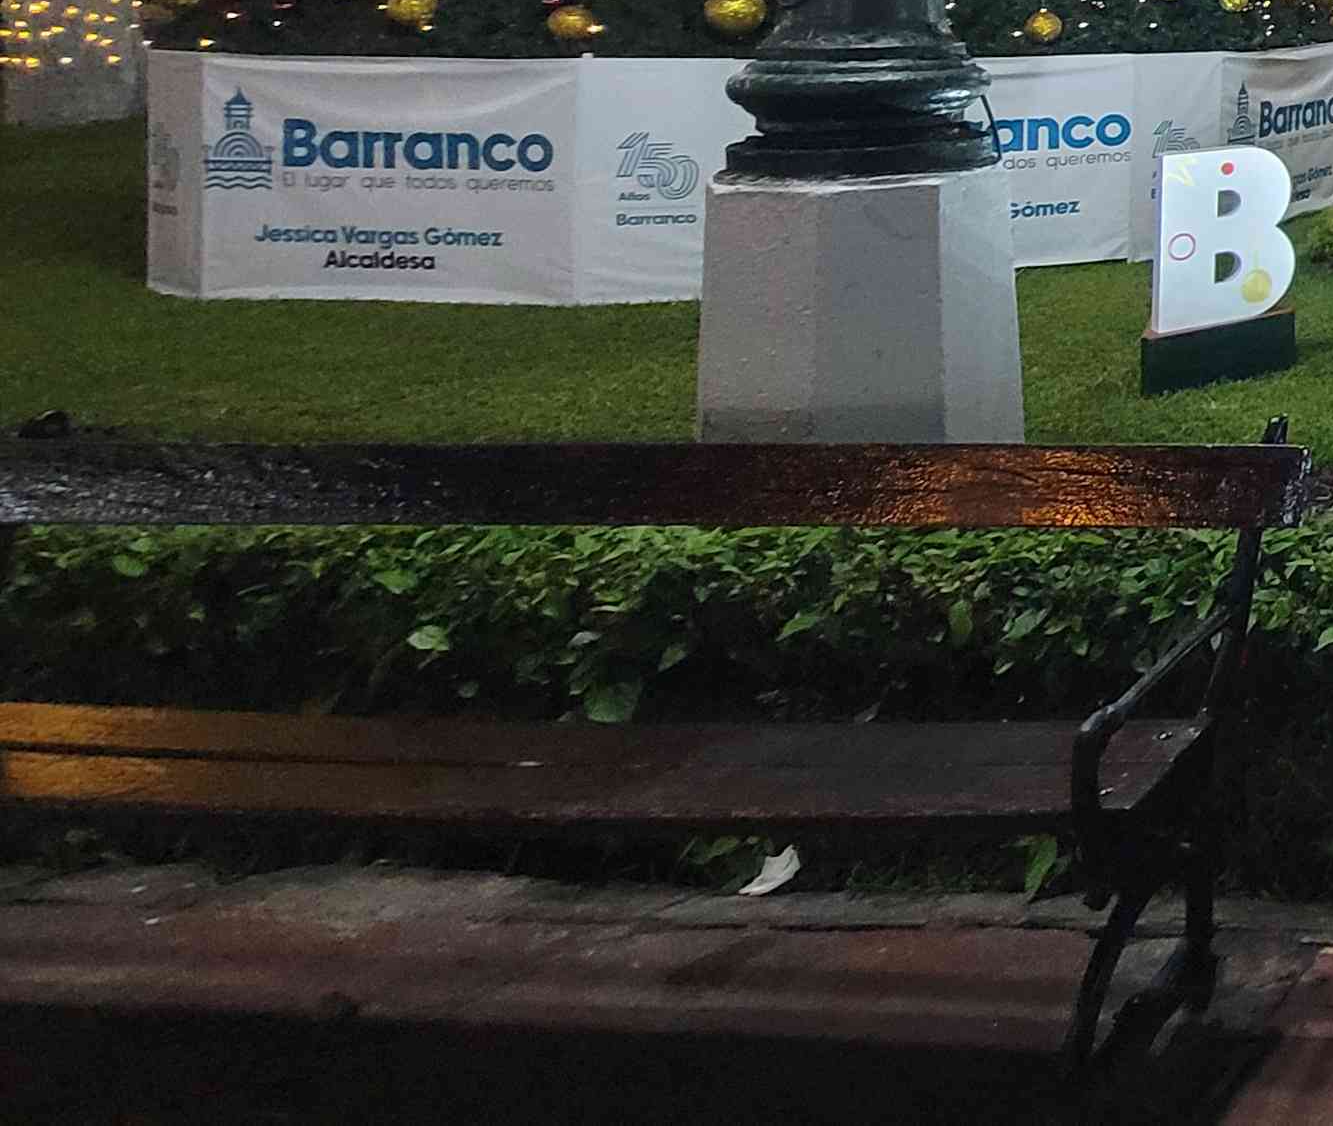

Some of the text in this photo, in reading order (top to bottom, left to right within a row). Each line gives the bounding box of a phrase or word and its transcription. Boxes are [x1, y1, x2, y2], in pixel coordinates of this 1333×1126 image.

[283, 118, 554, 172] Barranco
[992, 114, 1131, 153] anco
[616, 131, 700, 200] 150
[1002, 151, 1132, 170] dos queremos
[304, 173, 350, 192] lugar
[360, 175, 396, 192] que
[406, 175, 457, 190] todos
[465, 177, 555, 194] queremos
[616, 213, 697, 226] Barranco
[254, 224, 503, 249] Jessica Vargas Gómez
[323, 249, 436, 270] Alcaldesa
